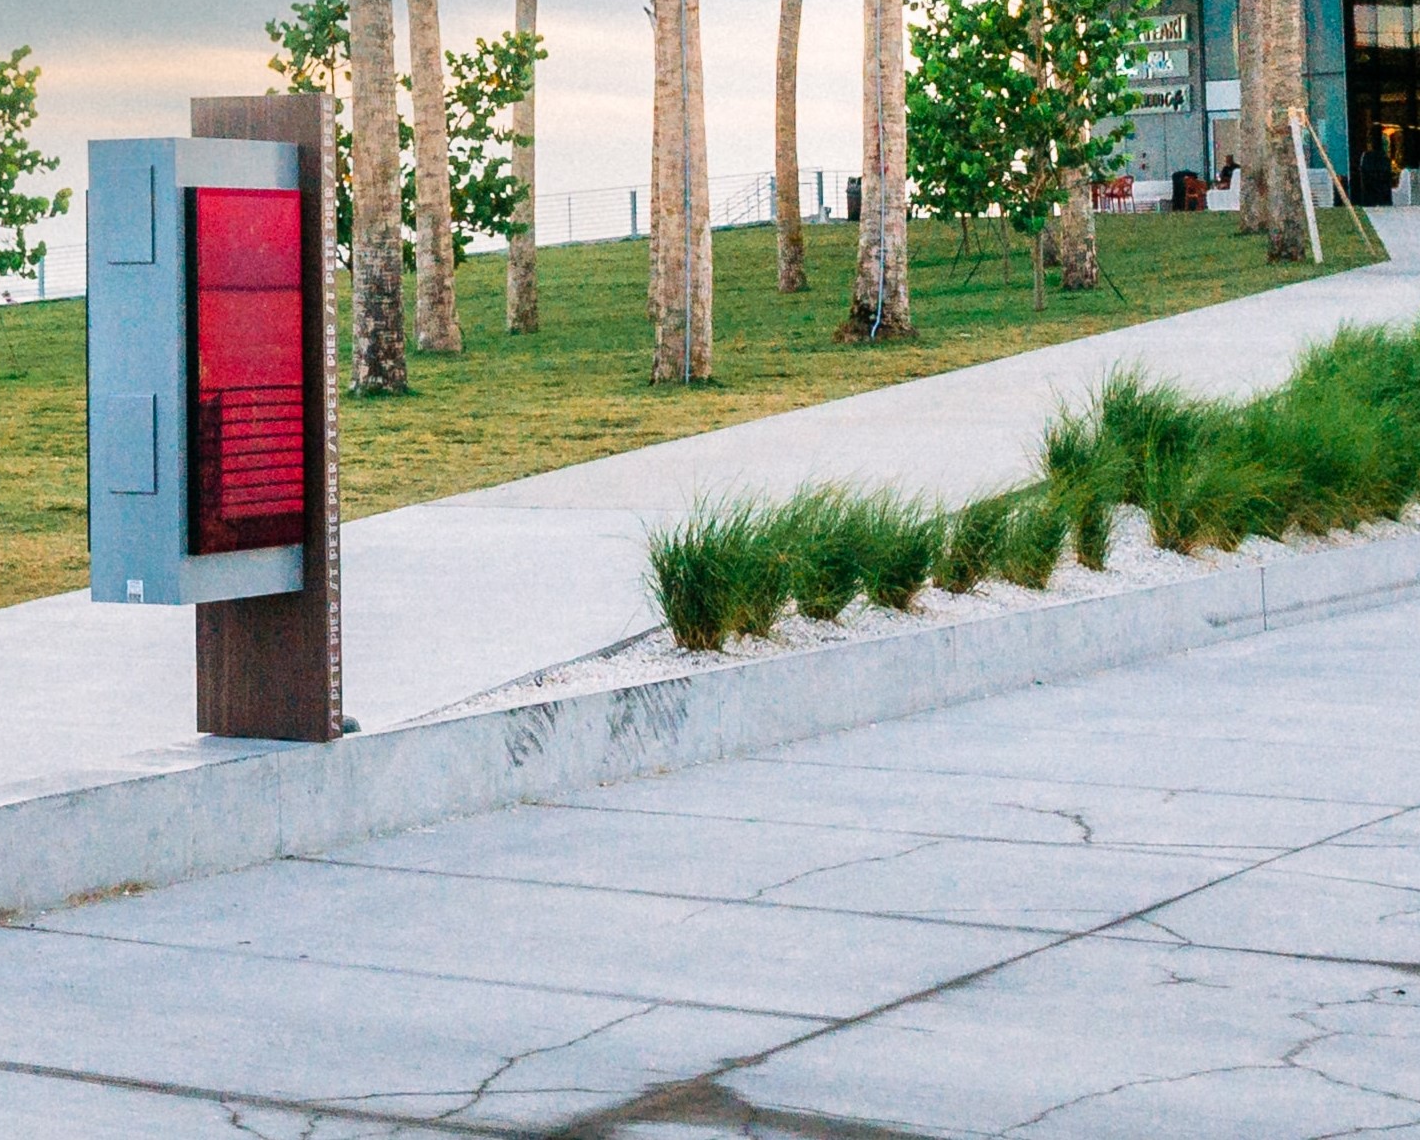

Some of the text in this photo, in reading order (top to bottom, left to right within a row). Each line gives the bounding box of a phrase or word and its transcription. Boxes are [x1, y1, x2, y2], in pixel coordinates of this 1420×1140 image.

[324, 186, 334, 230] PIER
[324, 236, 335, 284] PETE
[326, 323, 336, 367] PIER
[326, 373, 337, 422] PETE
[327, 462, 338, 505] PIER
[328, 511, 339, 560] PETE
[329, 601, 340, 645] PIER
[330, 651, 340, 700] PETE
